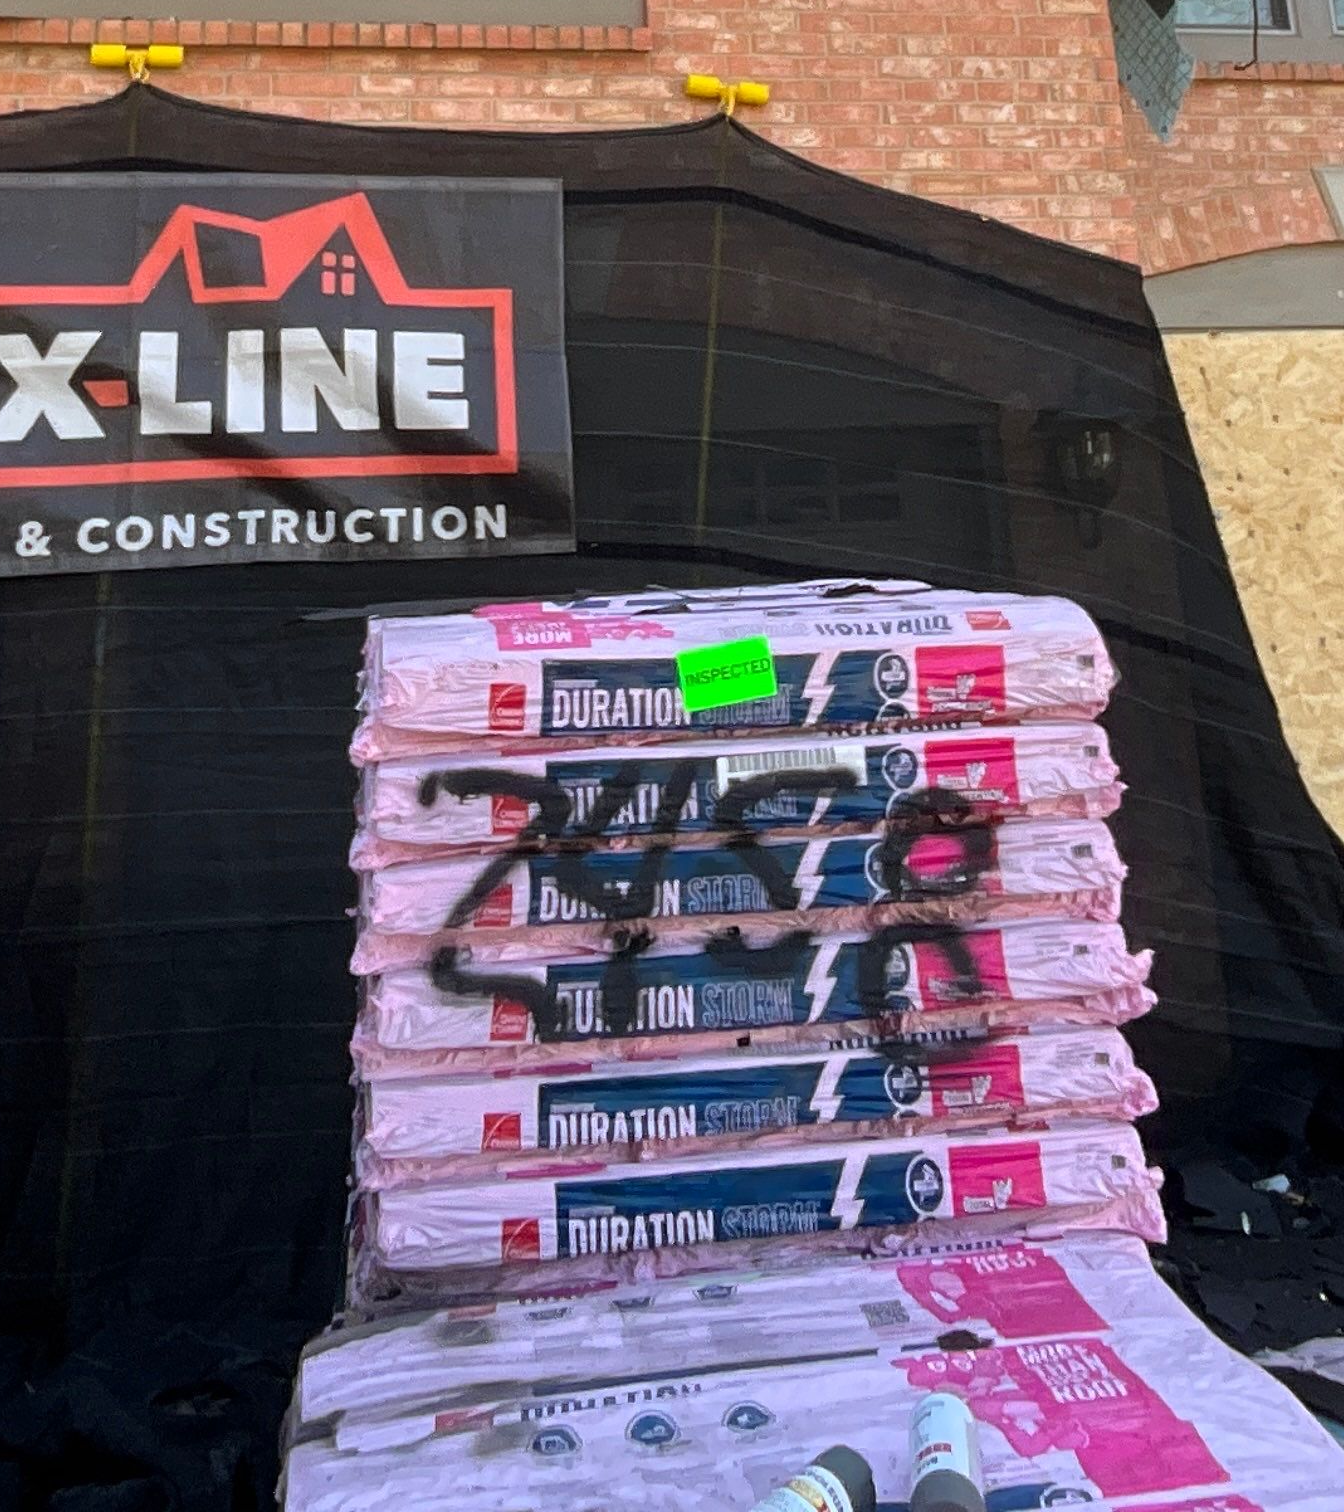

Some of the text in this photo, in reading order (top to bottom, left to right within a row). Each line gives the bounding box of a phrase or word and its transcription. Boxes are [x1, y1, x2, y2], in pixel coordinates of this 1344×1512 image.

[15, 520, 52, 558] &
[76, 504, 509, 554] CONSTRUCTION
[684, 657, 772, 686] INSPECTED
[551, 687, 693, 729] DURATION
[701, 977, 796, 1029] STORM
[549, 1103, 697, 1150] DURATION
[567, 1209, 716, 1258] DURATION
